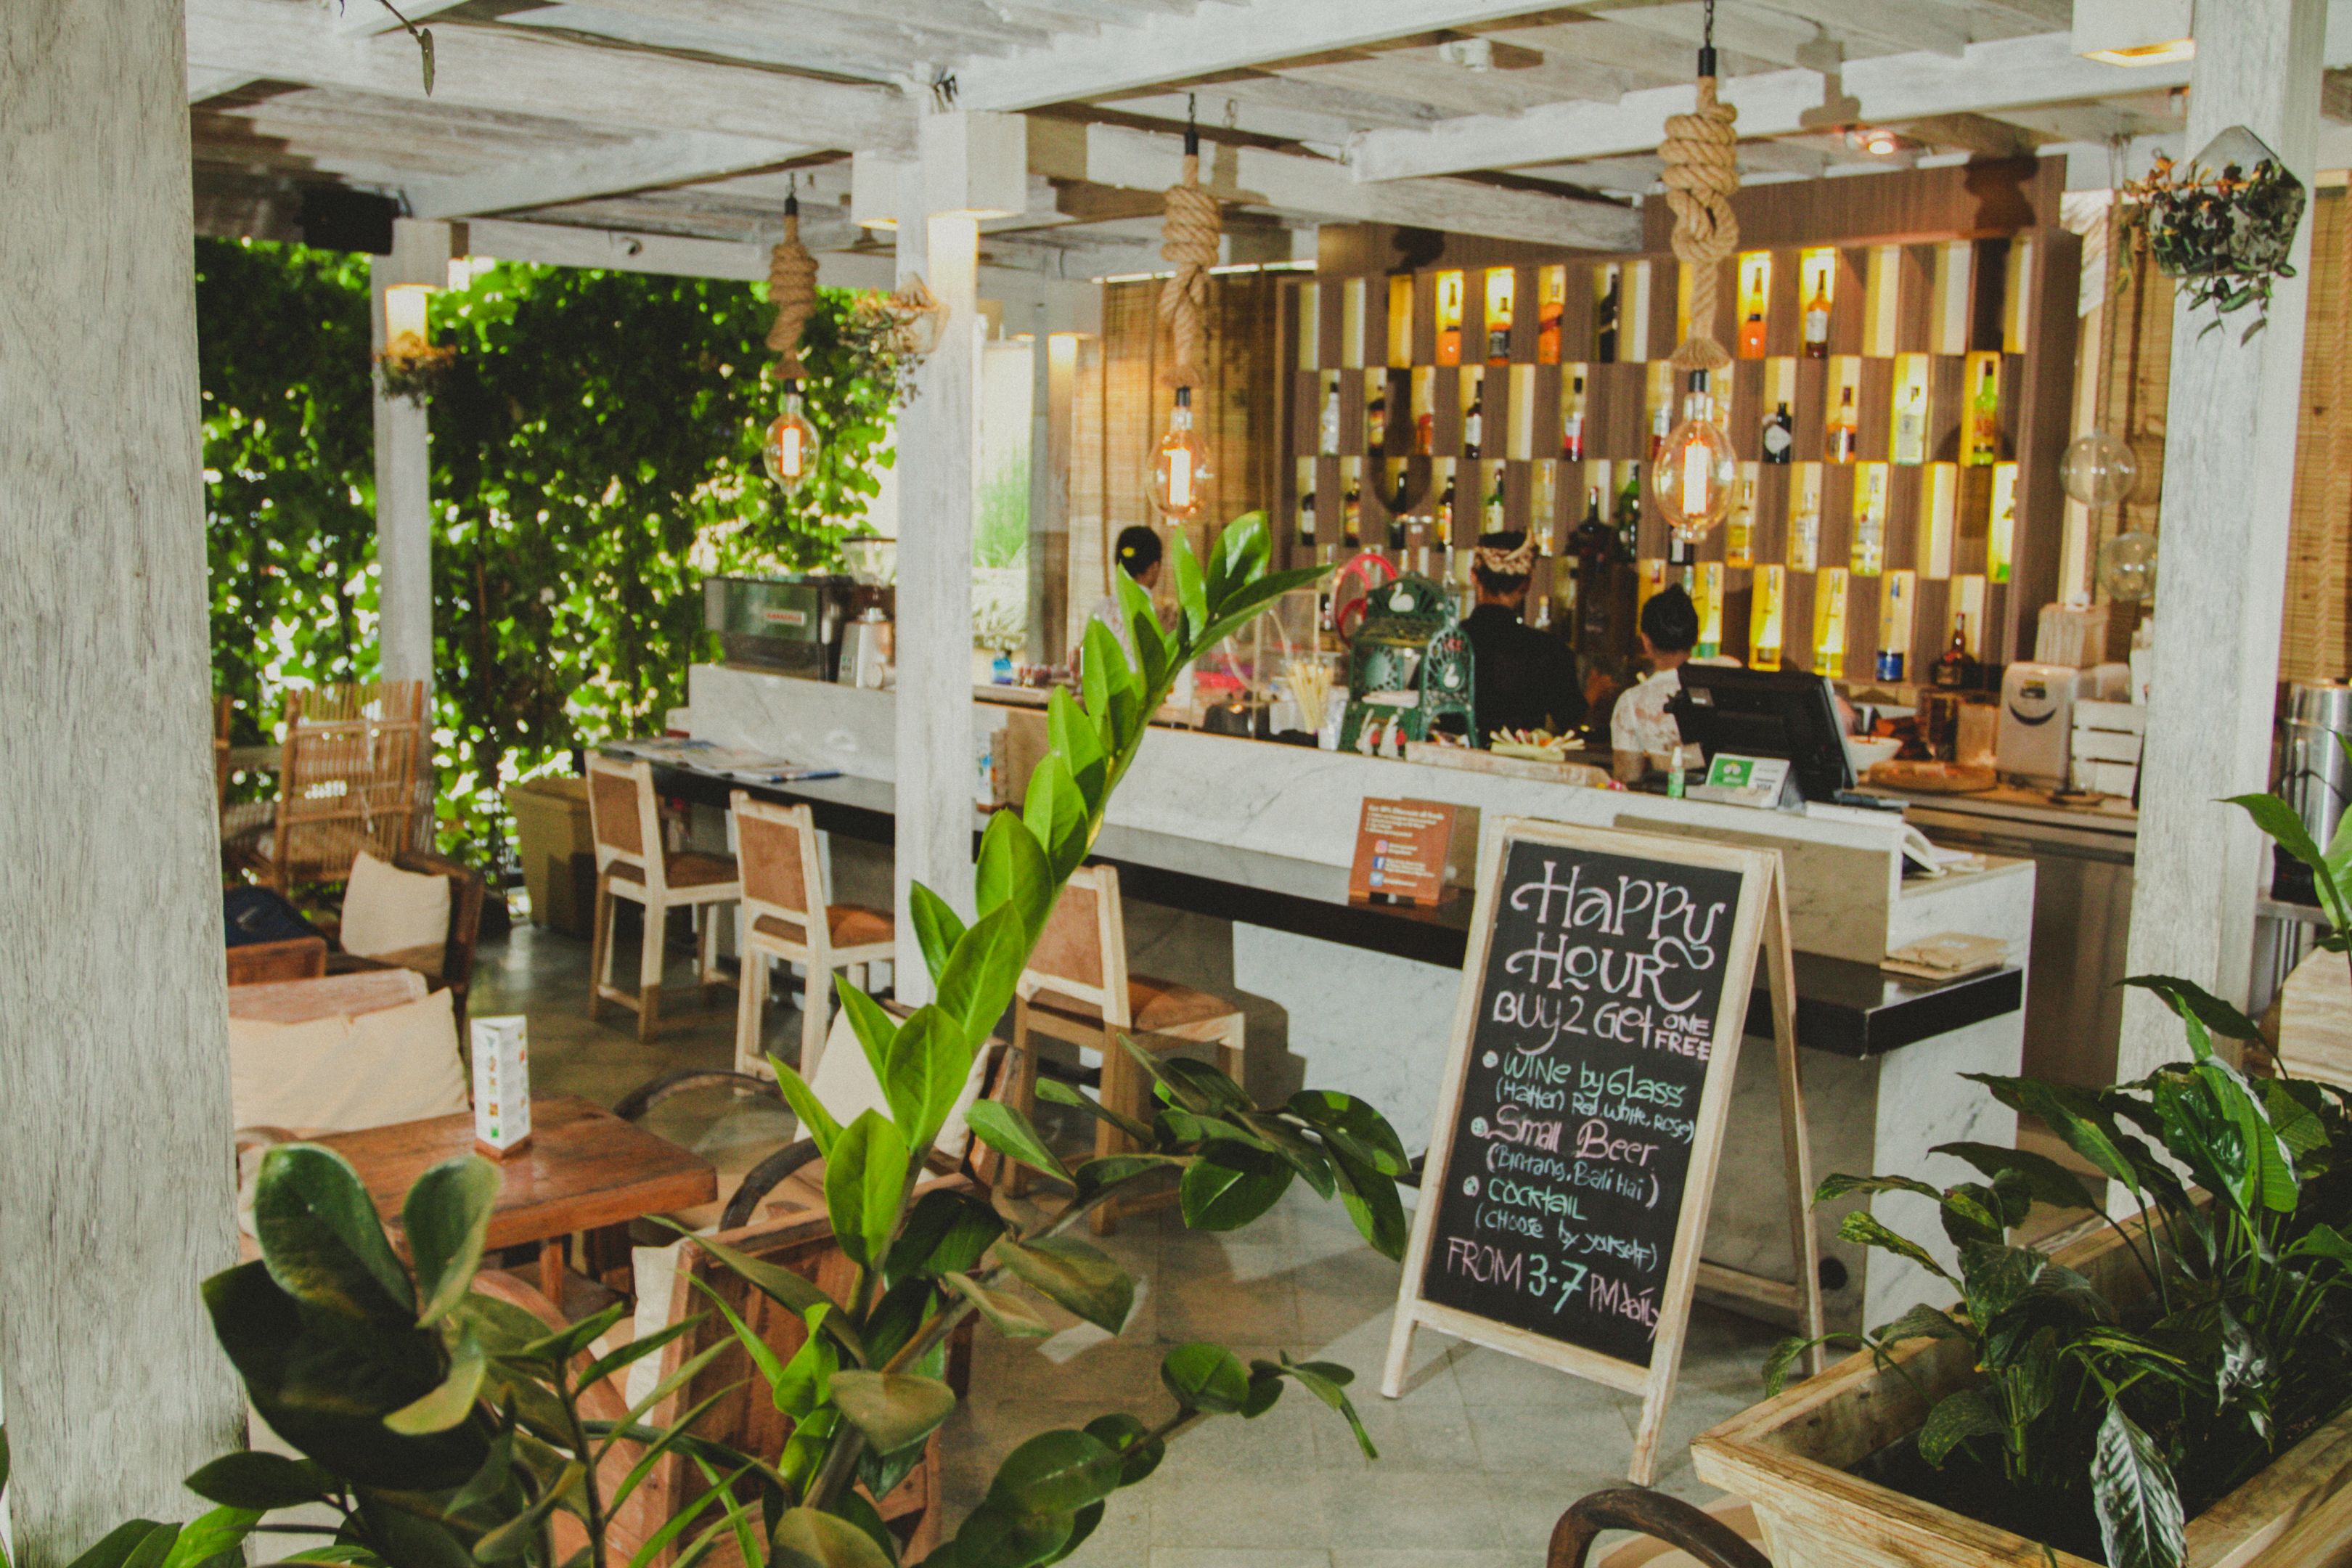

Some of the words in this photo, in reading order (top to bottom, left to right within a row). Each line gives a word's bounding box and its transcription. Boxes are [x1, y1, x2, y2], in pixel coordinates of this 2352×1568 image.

[1561, 995, 1588, 1036] 2
[1662, 1013, 1711, 1037] ONE
[1654, 1028, 1712, 1061] FREE
[1580, 1061, 1604, 1098] by
[1485, 1104, 1563, 1153] Small
[1576, 1119, 1660, 1167] Beer
[1573, 1160, 1614, 1191] Bali
[1558, 1219, 1580, 1251] by
[1447, 1236, 1524, 1292] FROM
[1589, 1273, 1620, 1316] PM
